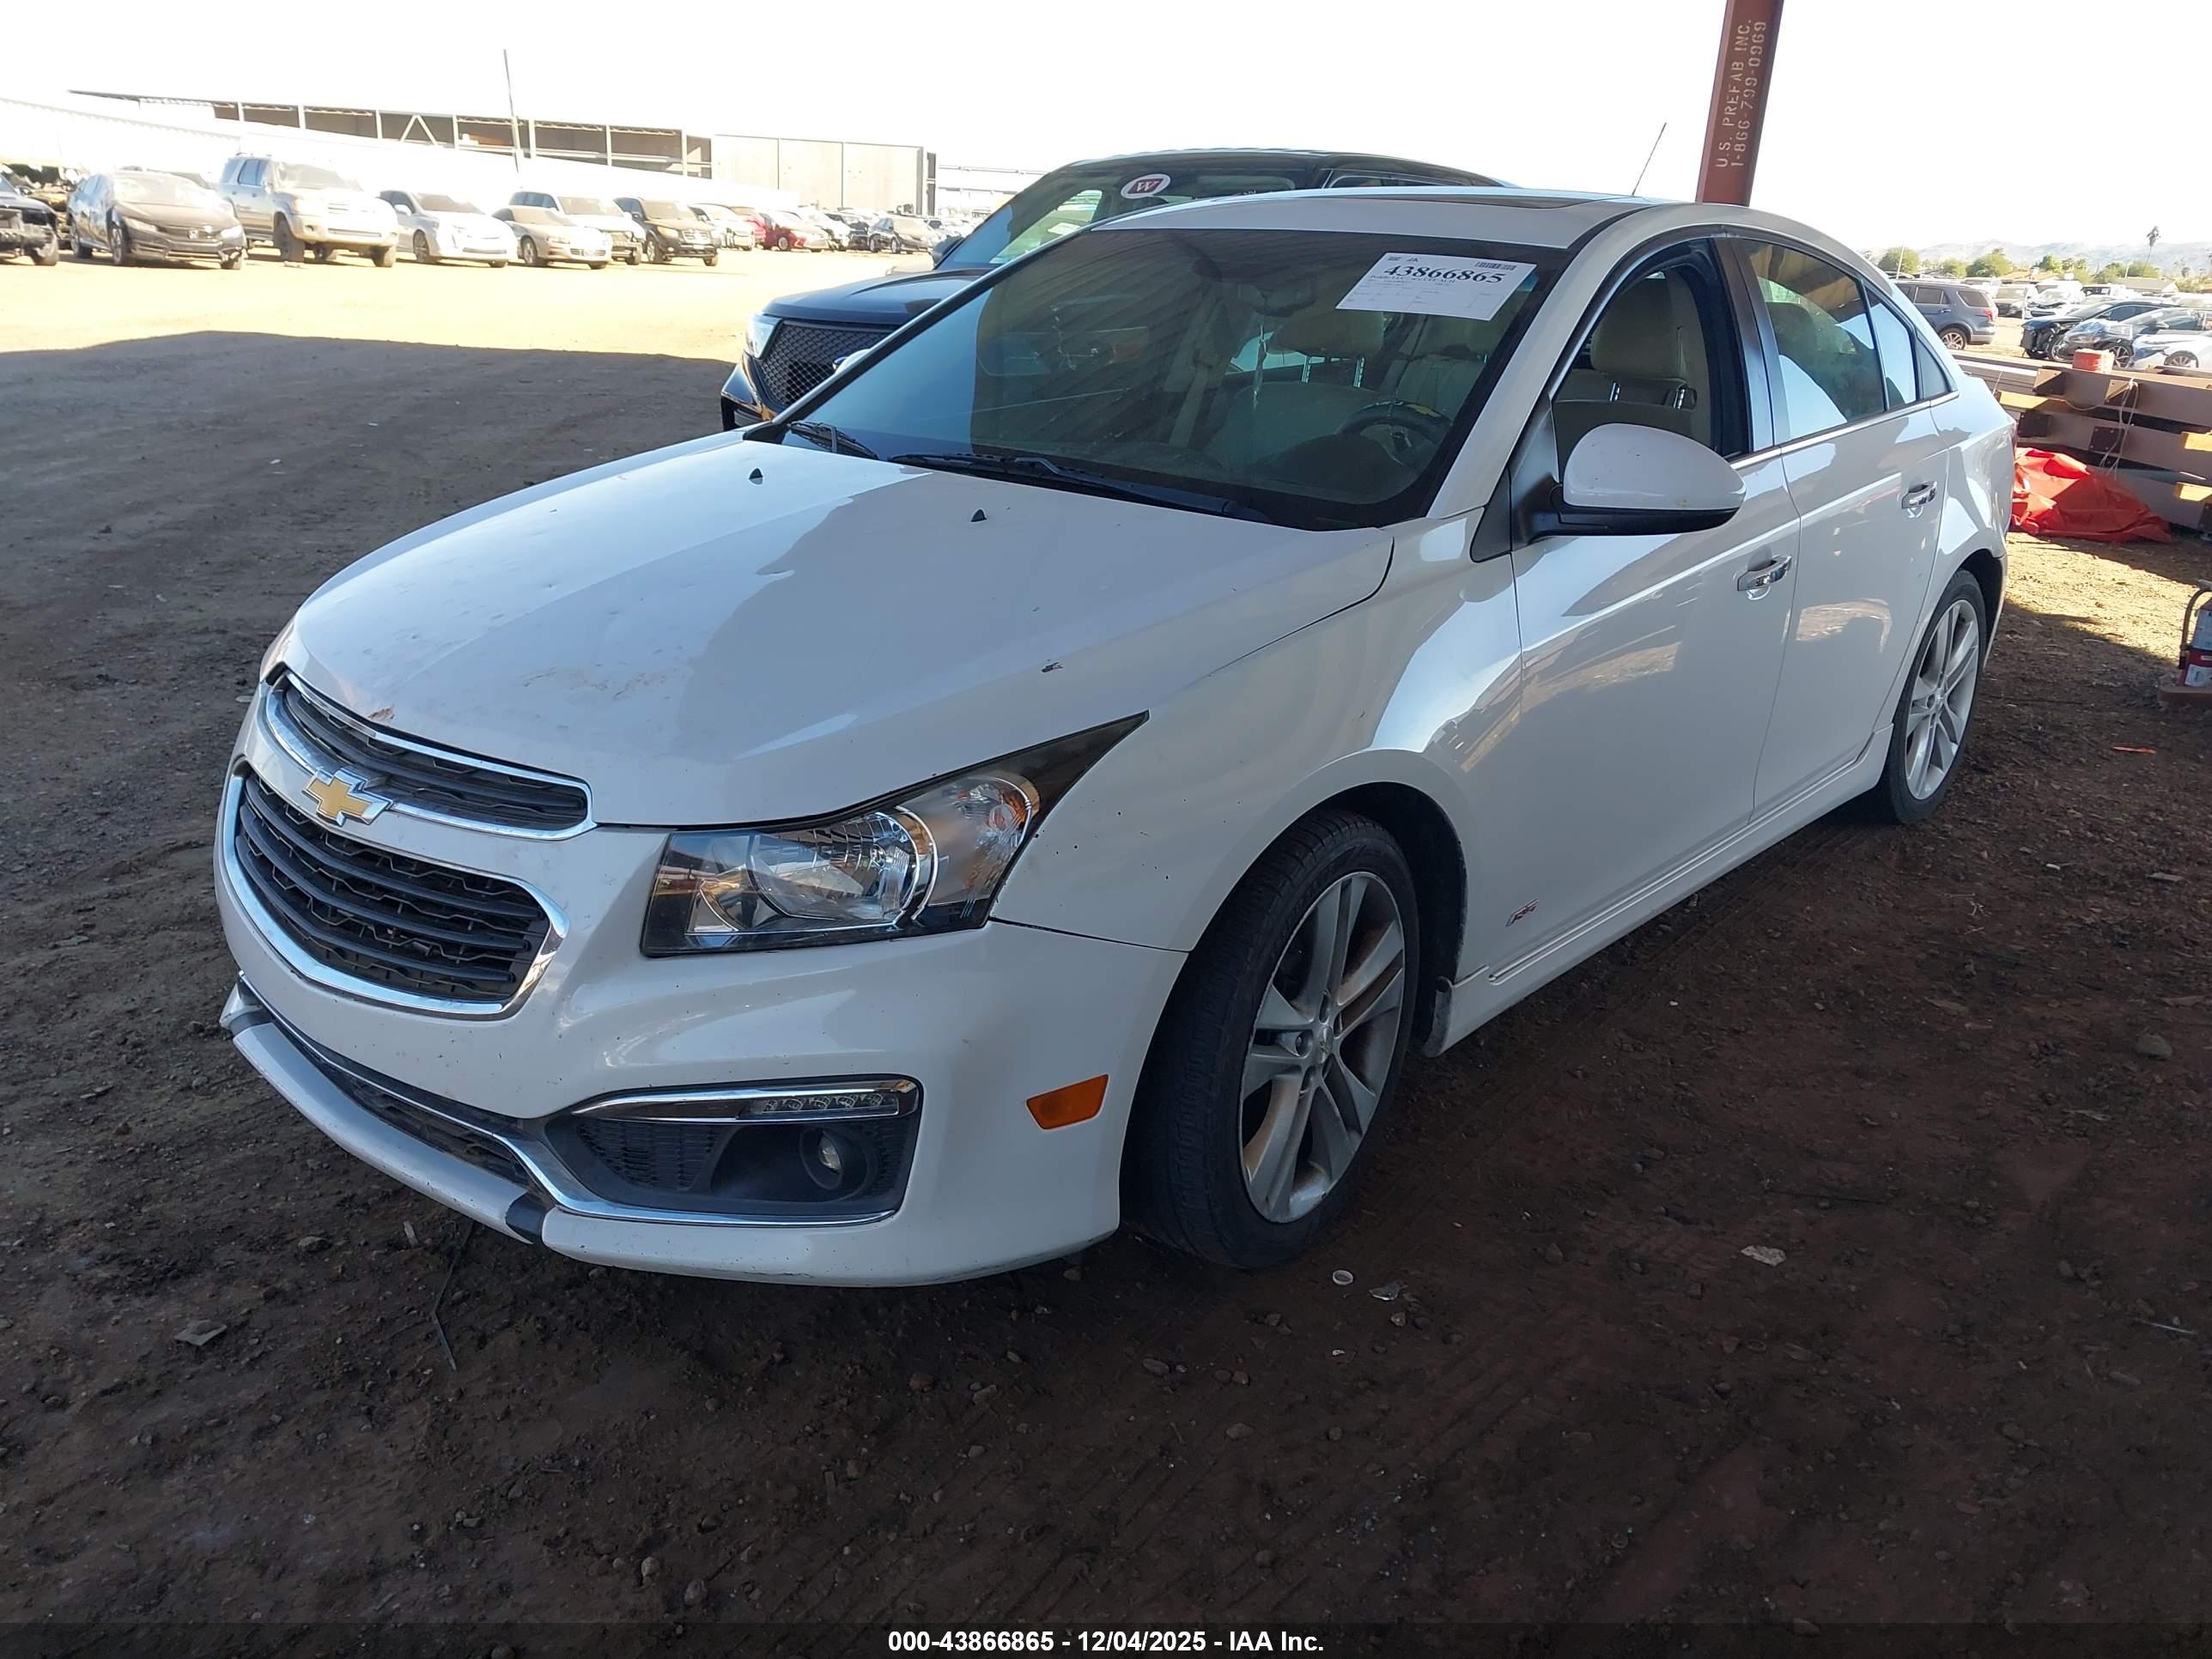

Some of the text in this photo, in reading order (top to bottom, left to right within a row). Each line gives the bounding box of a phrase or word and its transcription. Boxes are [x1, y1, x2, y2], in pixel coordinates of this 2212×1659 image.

[1716, 20, 1753, 167] U.S. PREFAB INC.
[1731, 21, 1767, 167] 1-866-799-0969
[1384, 264, 1506, 283] 43866865
